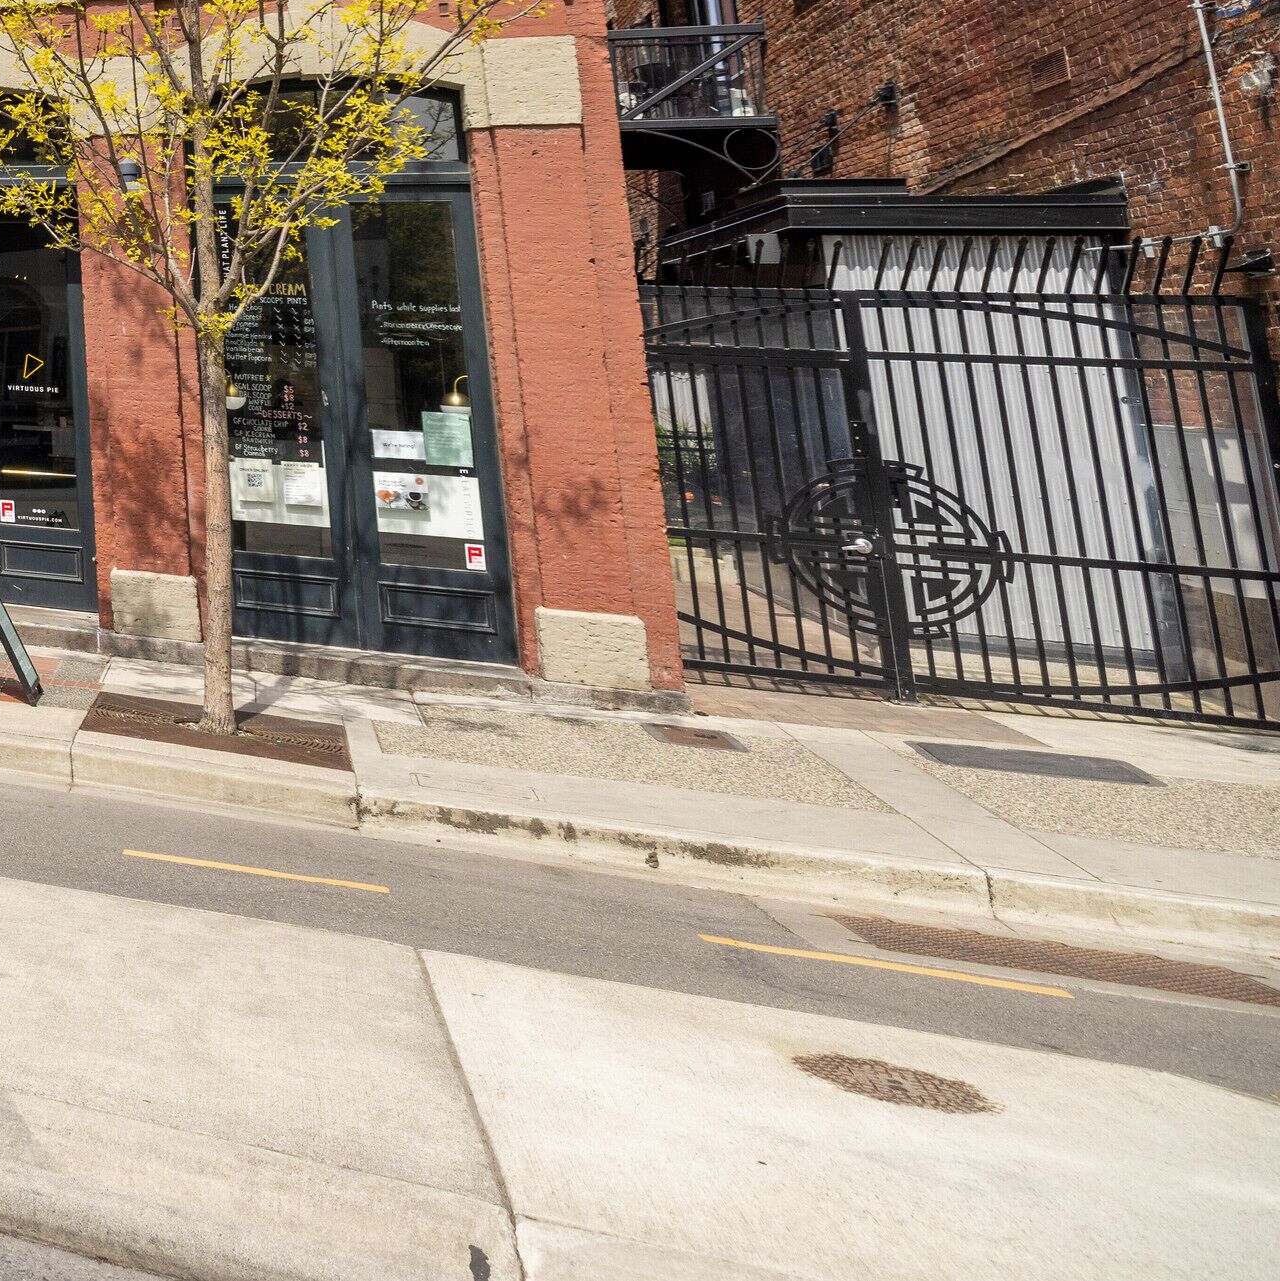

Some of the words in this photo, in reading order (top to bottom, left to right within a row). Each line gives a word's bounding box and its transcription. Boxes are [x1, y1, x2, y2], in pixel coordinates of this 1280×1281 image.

[269, 283, 307, 297] CREAM
[260, 296, 284, 304] SCOOPS
[286, 297, 308, 305] PINTS
[371, 300, 393, 311] Pints
[397, 302, 417, 312] while
[7, 384, 44, 393] VIRTUOUS
[46, 386, 59, 394] PIE
[251, 384, 273, 392] SCOOP
